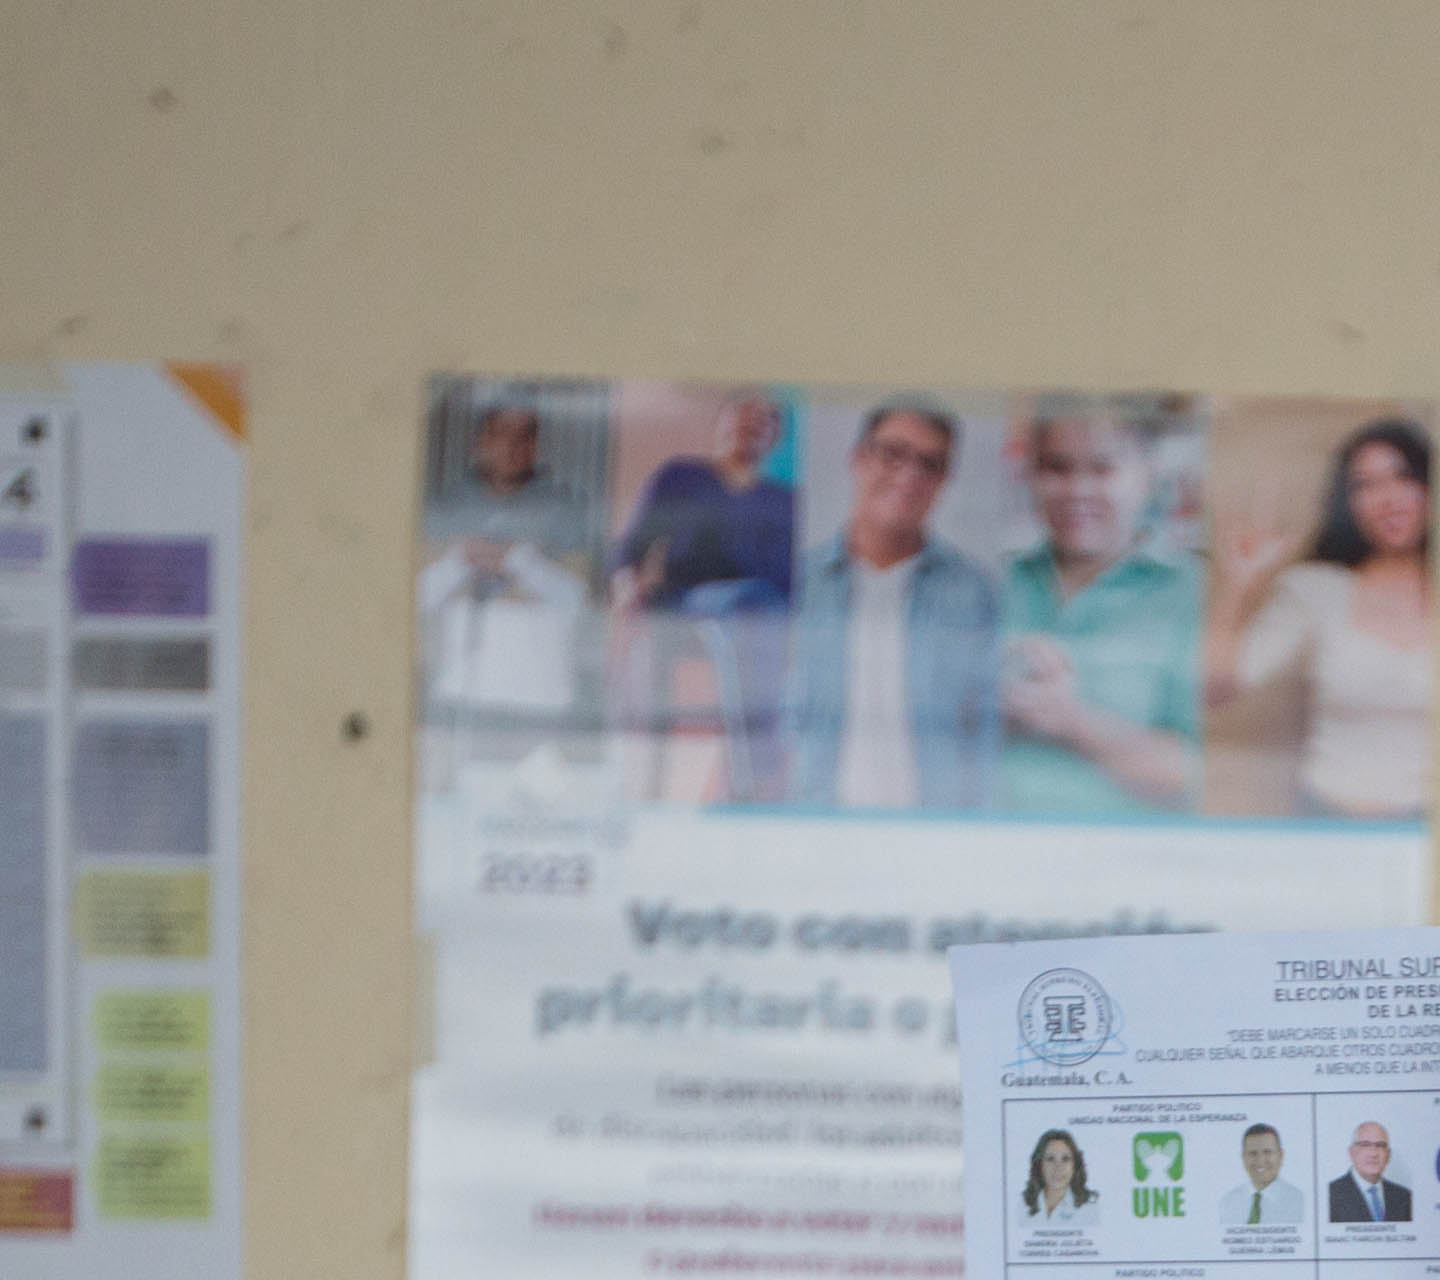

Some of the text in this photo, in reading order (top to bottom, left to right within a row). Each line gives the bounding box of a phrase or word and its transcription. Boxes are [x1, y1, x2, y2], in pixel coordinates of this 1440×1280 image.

[625, 897, 781, 954] Voto
[795, 908, 911, 954] con
[1276, 958, 1392, 980] TRIBUNAL
[1275, 983, 1360, 1002] ELECCIÓN
[1366, 985, 1388, 999] DE
[1368, 1004, 1391, 1018] DE
[1396, 1004, 1417, 1017] LA
[1363, 1025, 1395, 1039] SOLO
[1132, 1187, 1186, 1218] UNE
